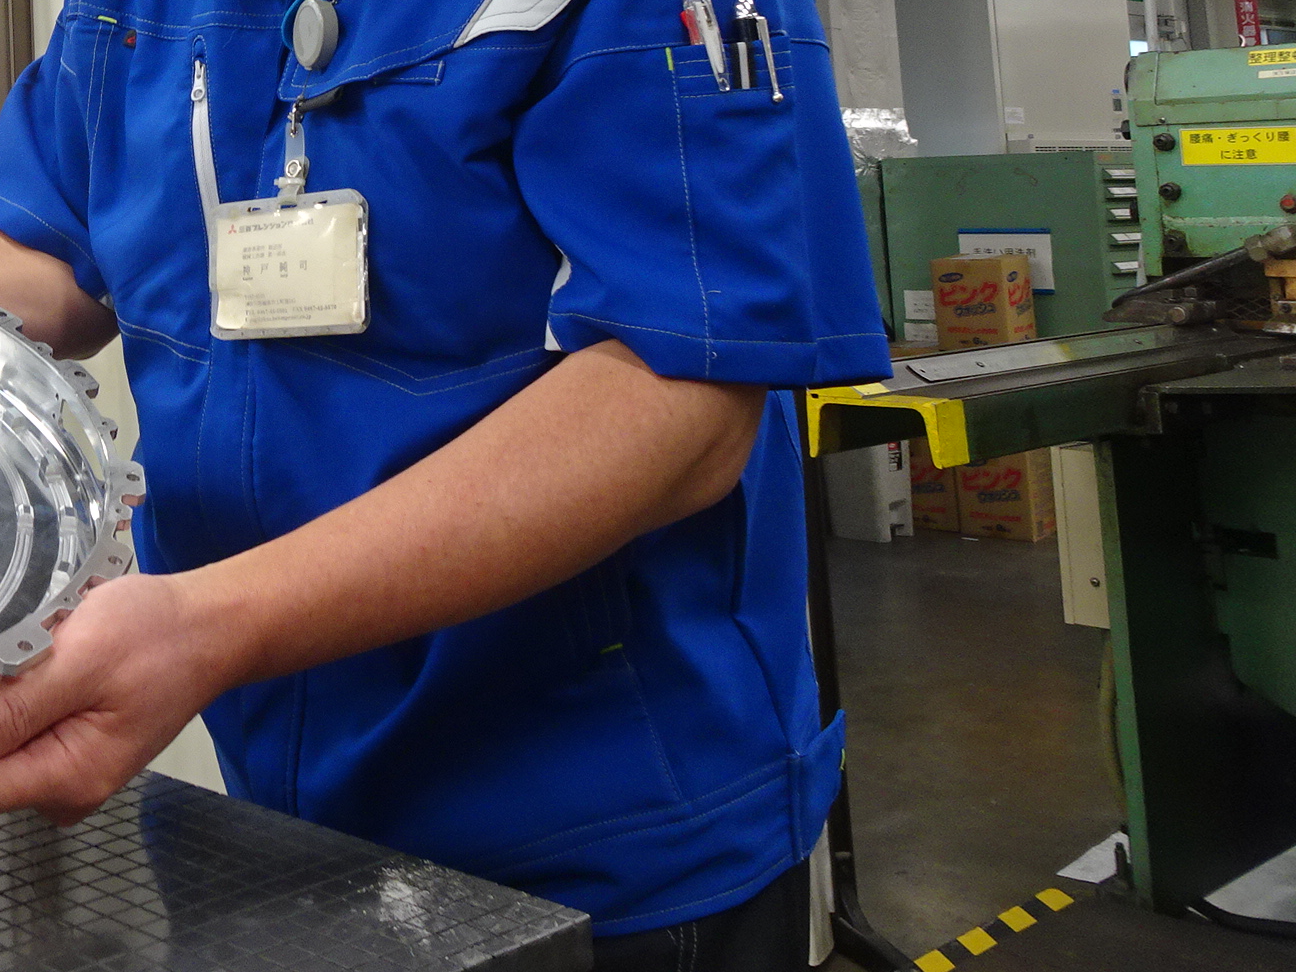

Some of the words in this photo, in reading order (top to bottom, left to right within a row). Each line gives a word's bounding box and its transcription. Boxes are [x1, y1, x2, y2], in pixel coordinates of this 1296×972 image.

[1189, 131, 1290, 144] 腰痛・ぎっくり腰
[1220, 149, 1257, 160] に注意
[939, 281, 998, 307] ピンク
